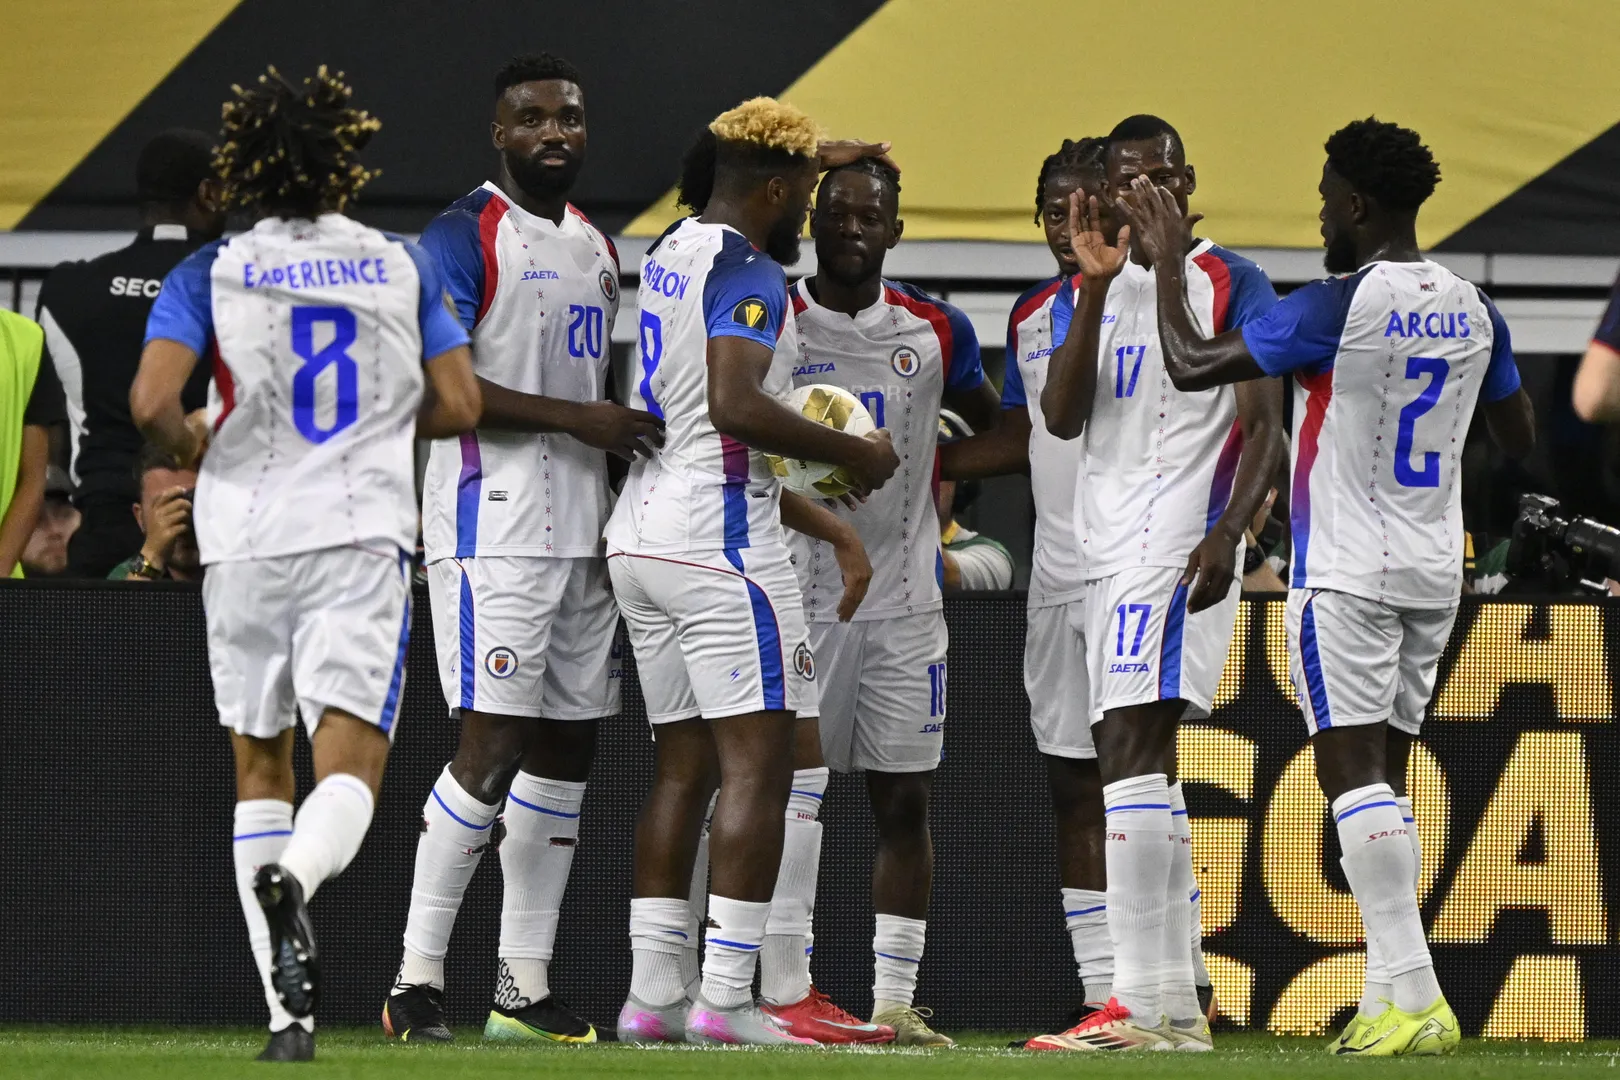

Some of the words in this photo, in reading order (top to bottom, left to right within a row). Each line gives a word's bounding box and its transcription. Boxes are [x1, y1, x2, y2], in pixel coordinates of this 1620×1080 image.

[110, 277, 160, 297] SEC
[520, 270, 559, 281] SAETA
[568, 304, 604, 359] 20
[1383, 311, 1471, 338] ARCUS
[291, 306, 358, 444] 8
[1115, 345, 1147, 398] 17
[1394, 357, 1450, 488] 2
[1116, 604, 1153, 657] 17
[1108, 663, 1150, 673] SAETA
[918, 723, 944, 733] SAE
